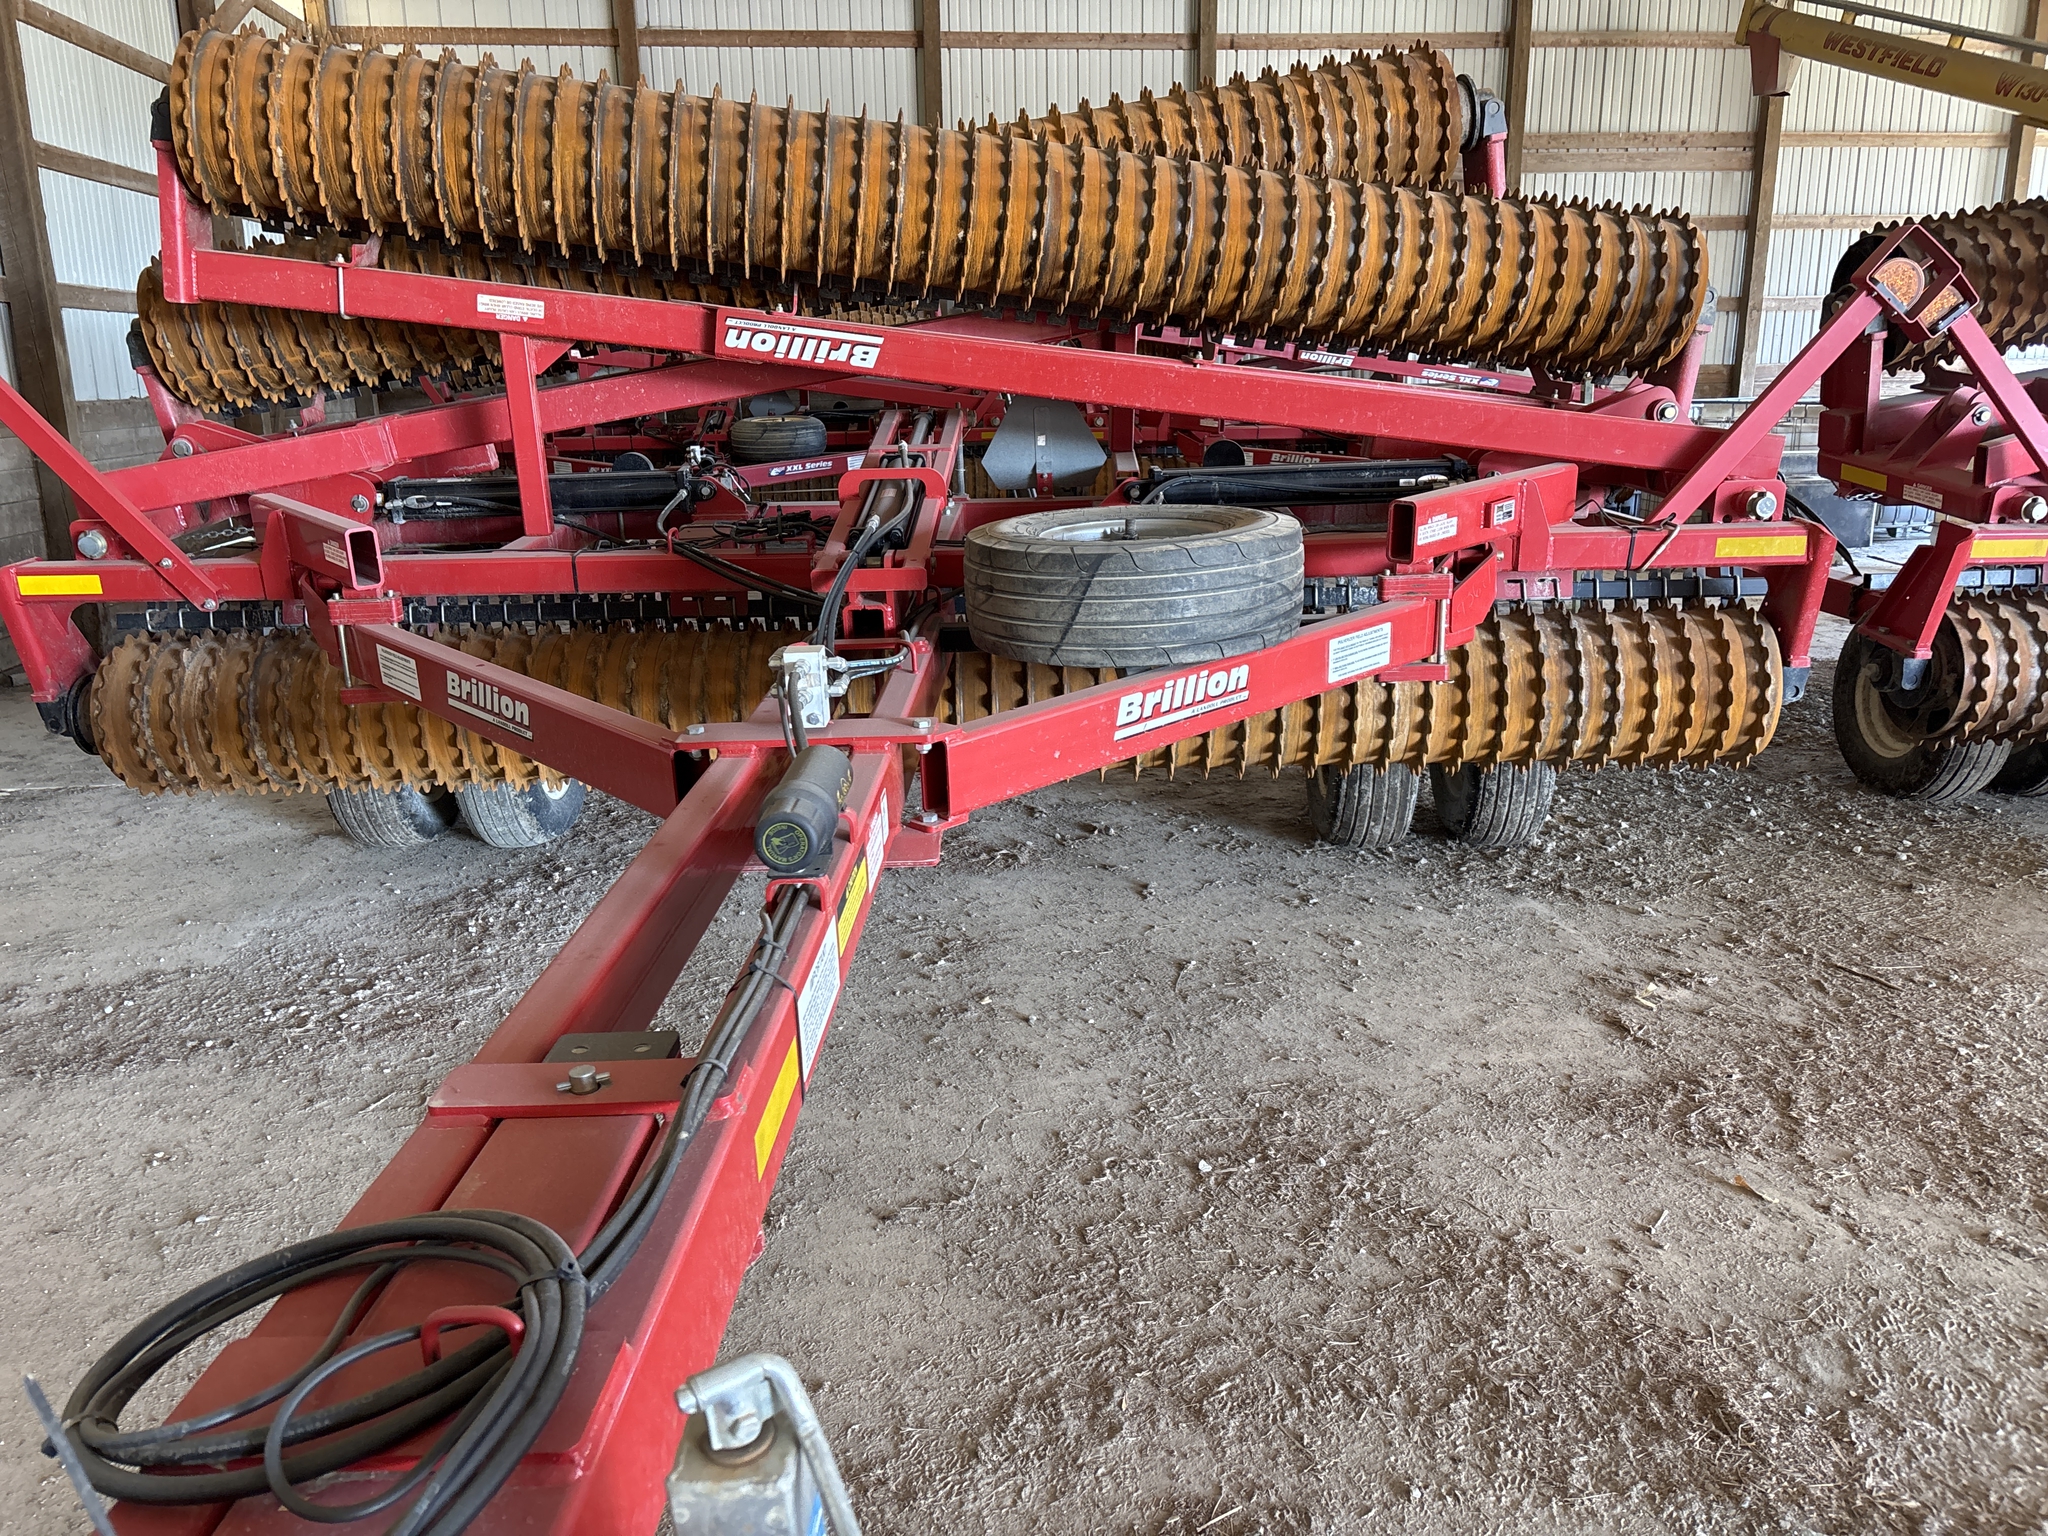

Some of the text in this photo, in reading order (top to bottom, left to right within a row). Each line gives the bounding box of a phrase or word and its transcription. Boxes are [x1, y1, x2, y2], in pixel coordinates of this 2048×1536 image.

[1823, 31, 1949, 78] WESTFIELD
[724, 328, 881, 369] Brillion
[1300, 352, 1354, 366] Brillion
[1421, 370, 1481, 385] XXL Series
[786, 460, 833, 472] XXL Series
[1271, 453, 1320, 463] Brillion
[446, 670, 530, 727] Brillion
[1116, 664, 1250, 727] Brillion
